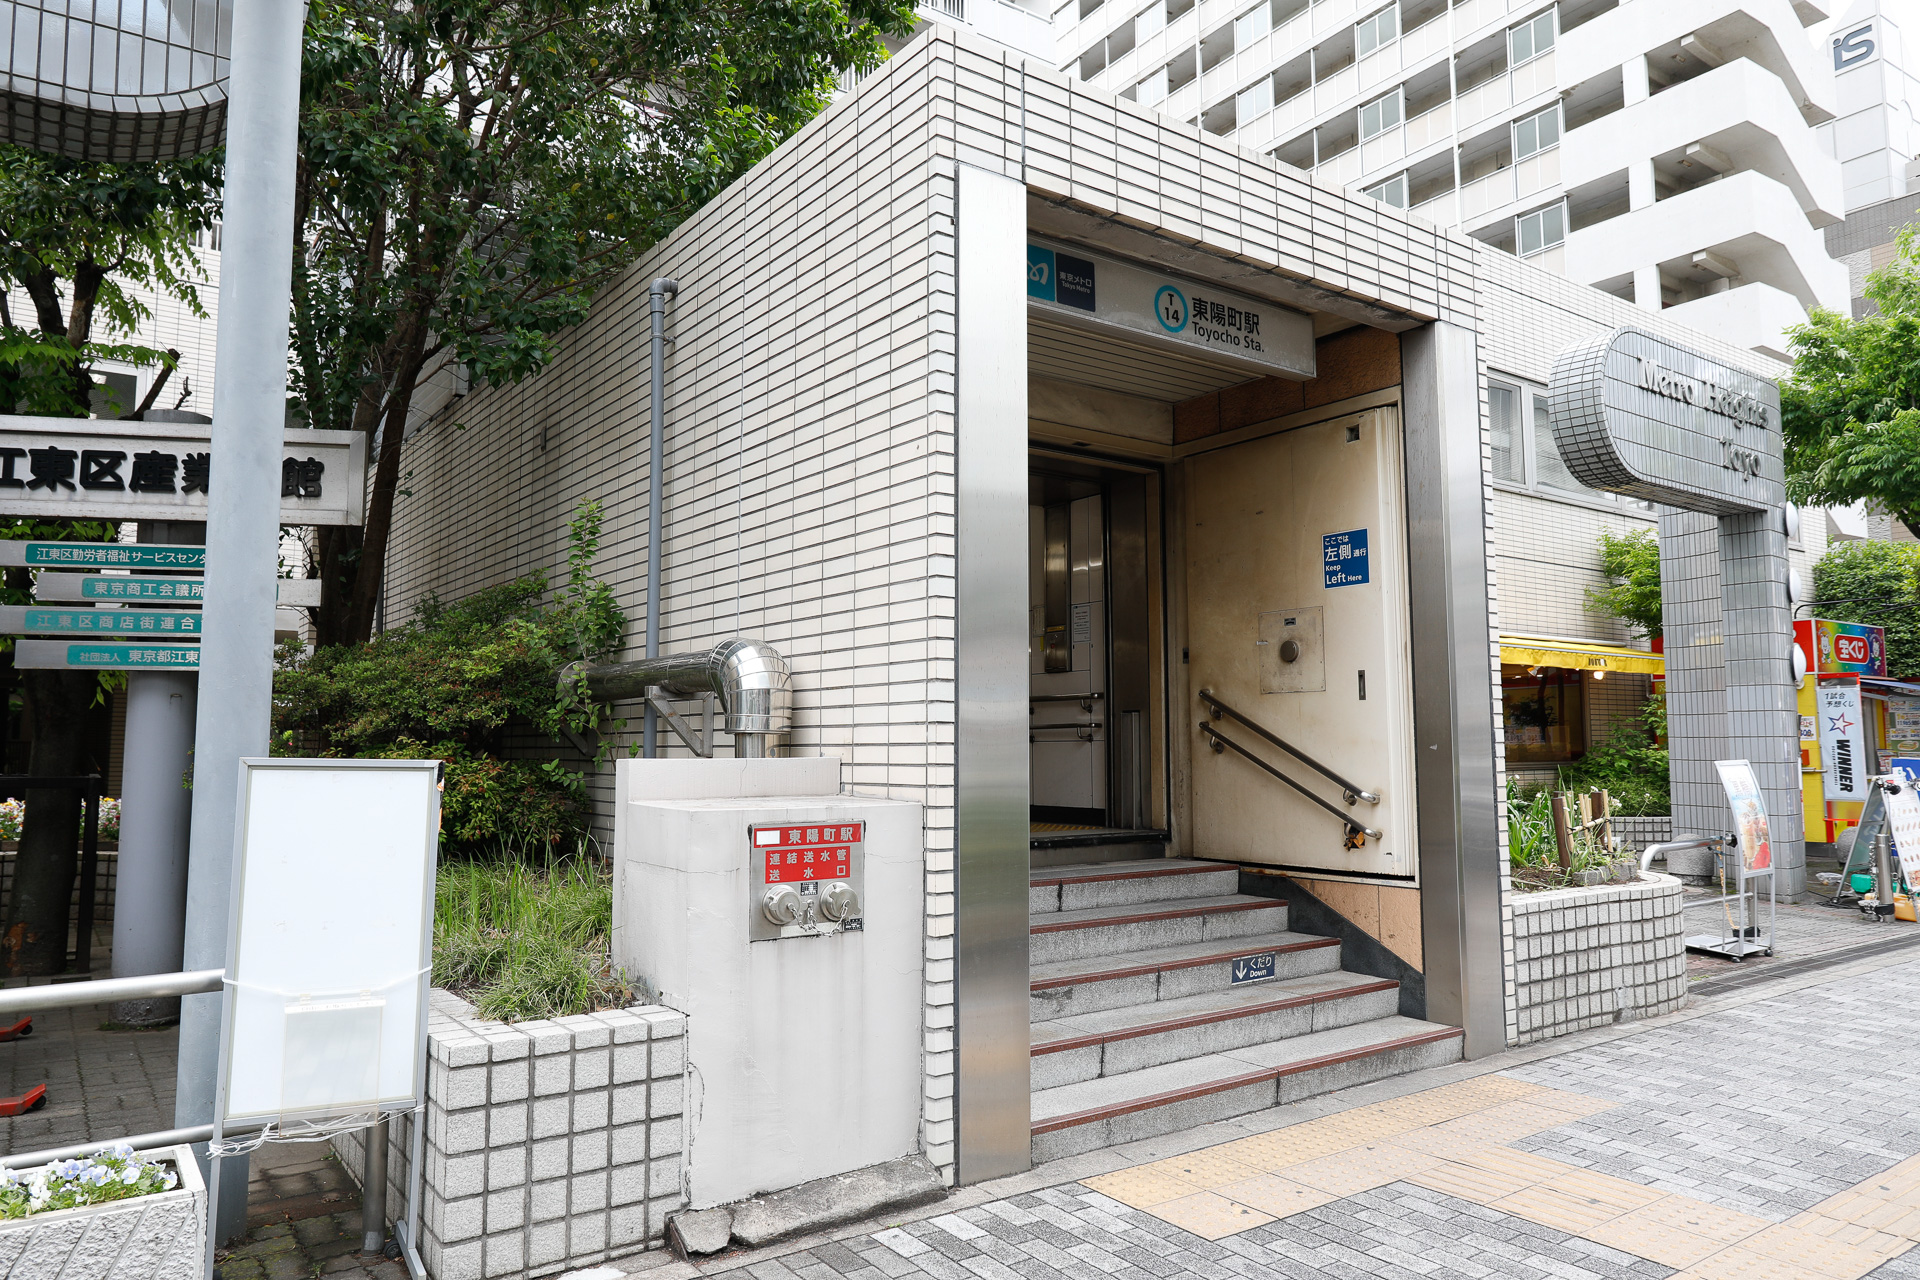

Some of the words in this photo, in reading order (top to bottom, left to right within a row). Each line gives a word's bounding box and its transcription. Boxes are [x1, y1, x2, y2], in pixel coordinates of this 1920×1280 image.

[1060, 271, 1092, 287] 東京メトロ
[1061, 281, 1076, 290] Tokyo
[1076, 285, 1091, 293] Metro
[1168, 293, 1175, 306] T
[1164, 306, 1180, 323] 14
[1191, 297, 1260, 336] 東陽町駅
[1192, 321, 1240, 346] Toyocho
[1243, 330, 1265, 353] Sta.
[1637, 355, 1695, 404] Metro
[1703, 378, 1769, 428] Heights
[1720, 435, 1761, 482] Toyo
[0, 445, 325, 498] 江東区産業館
[1325, 535, 1349, 545] ここでは
[1327, 572, 1346, 584] Left
[94, 581, 204, 597] 東京商工会議所
[37, 614, 203, 630] 江東区商店街連合
[79, 652, 121, 662] 社団法人
[128, 649, 200, 663] 東京都江東
[1838, 639, 1865, 659] 宝くじ
[1825, 692, 1846, 700] 1試合
[1825, 700, 1854, 708] 予想くじ
[1836, 739, 1853, 793] WINNER
[788, 827, 853, 844] 東陽町駅
[769, 848, 847, 865] 連結送水管
[769, 865, 846, 881] 送水口
[1250, 956, 1271, 968] くだり
